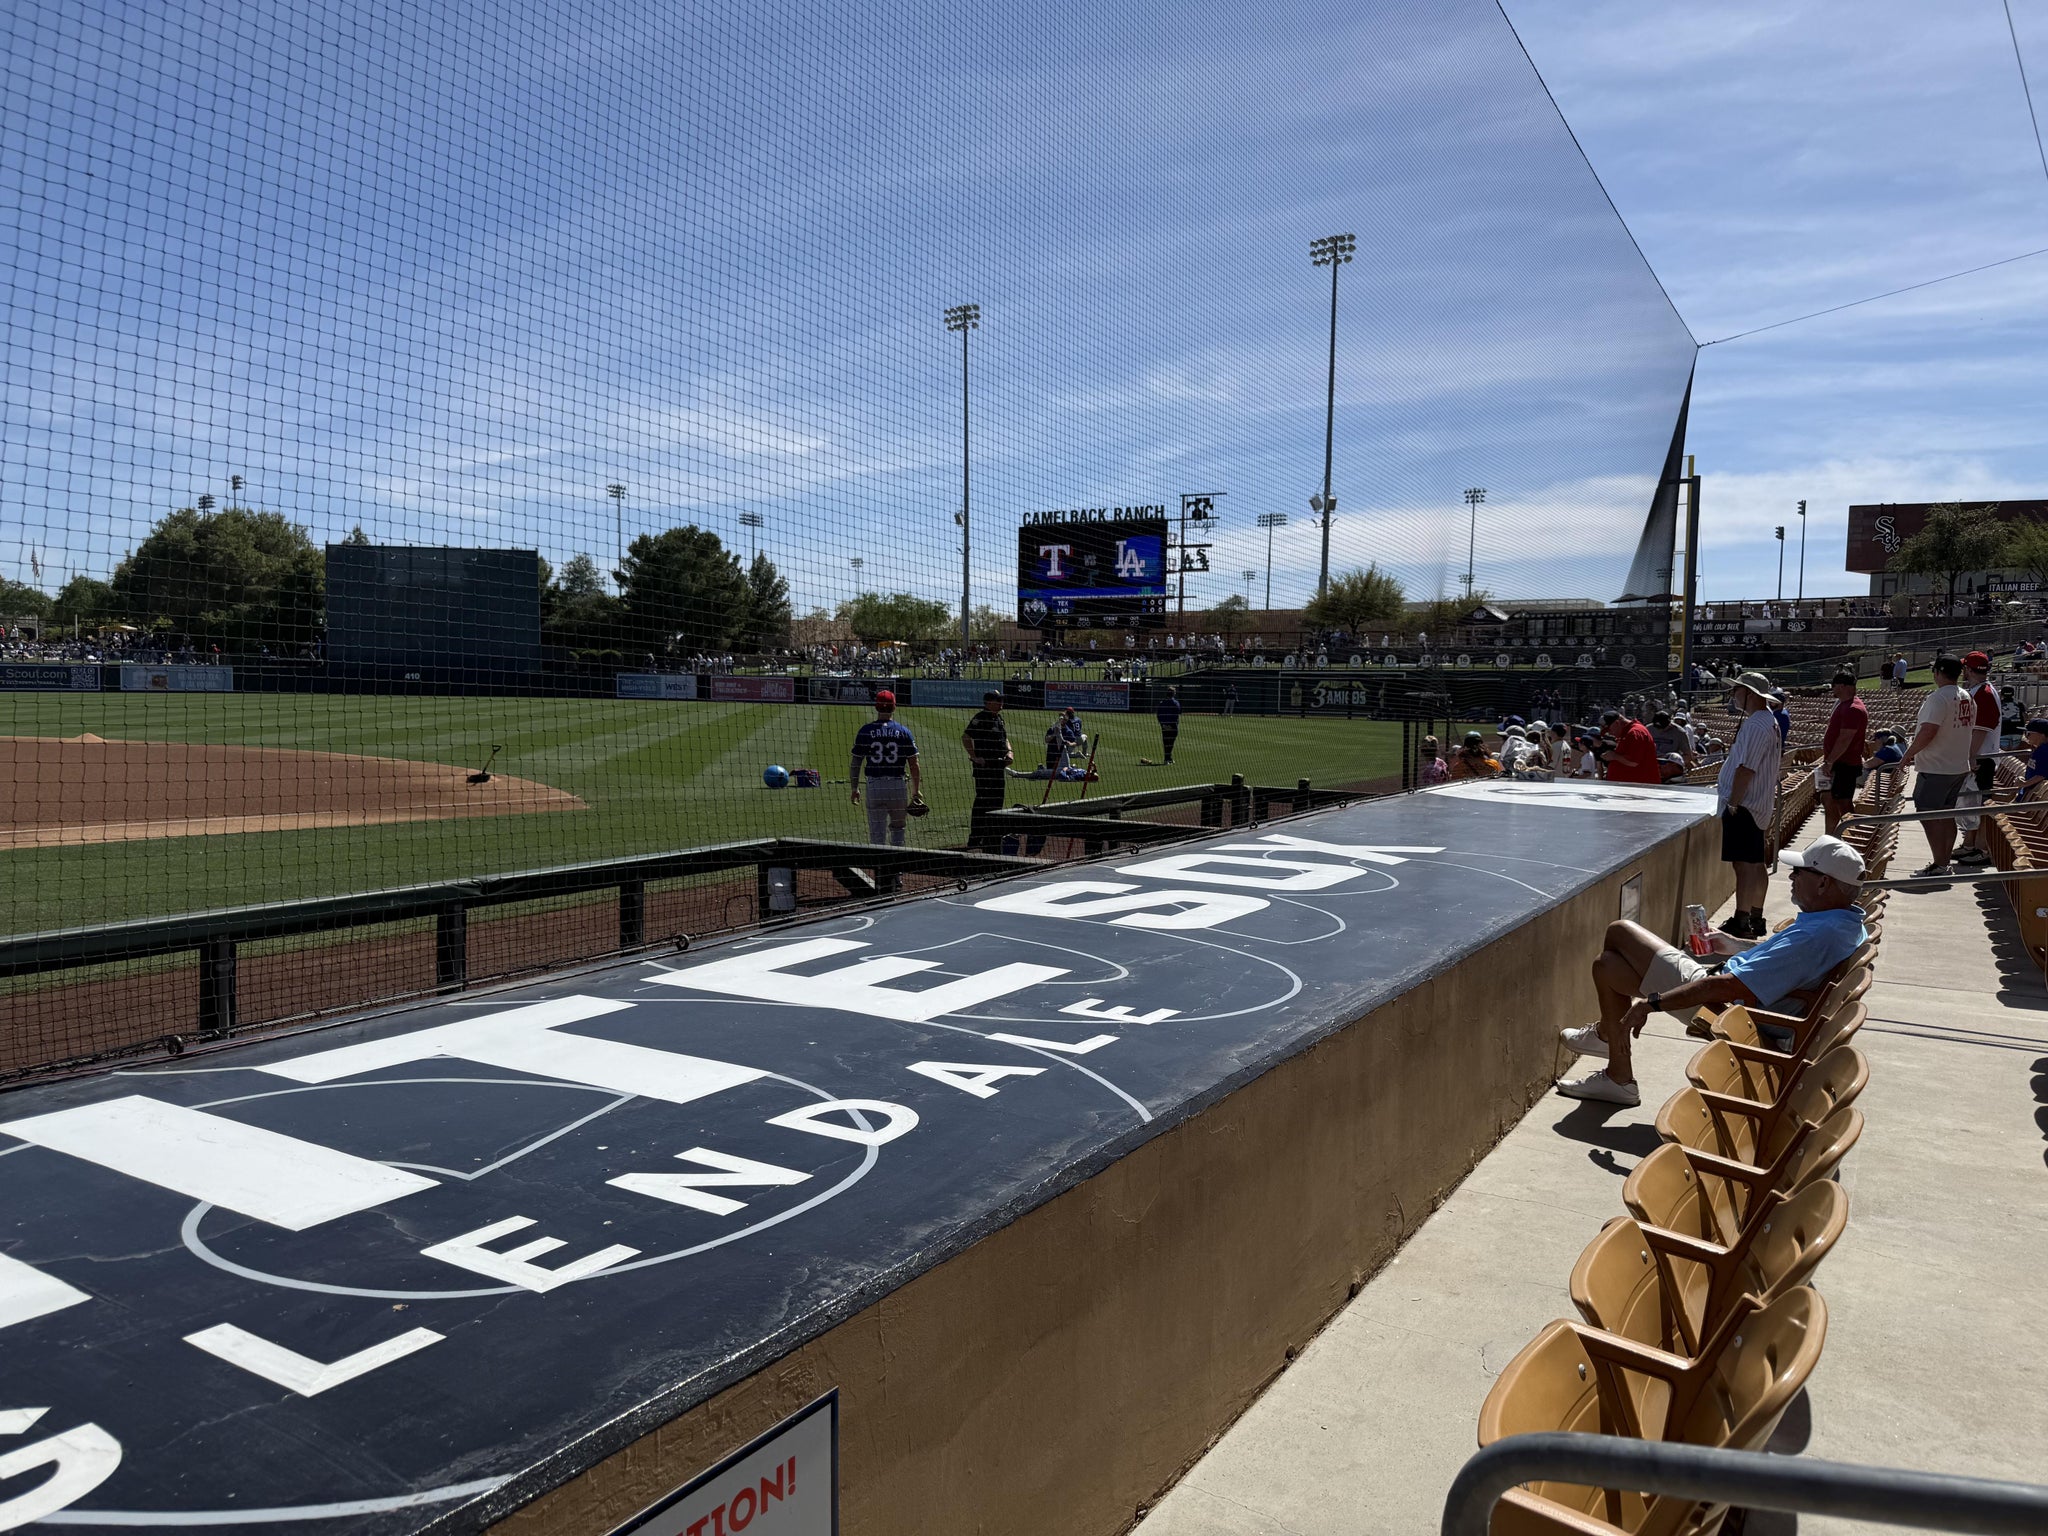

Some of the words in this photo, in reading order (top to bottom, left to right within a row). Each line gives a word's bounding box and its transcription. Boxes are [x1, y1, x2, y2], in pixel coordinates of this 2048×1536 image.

[1022, 508, 1107, 526] CAMELBACK
[1114, 504, 1165, 521] RANCH
[1039, 544, 1074, 578] T
[1115, 540, 1146, 578] LA
[1988, 582, 2018, 592] ITALIAN
[2020, 582, 2040, 592] BEEF
[1714, 623, 1726, 631] COLD
[1727, 622, 1740, 631] BEER
[1787, 621, 1806, 632] 805
[6, 668, 68, 679] Scout.com
[405, 672, 420, 680] 410
[665, 683, 687, 691] WEST
[1310, 688, 1326, 708] 3
[870, 742, 898, 764] 33
[974, 832, 1446, 931] SOX
[674, 1456, 796, 1536] TION!
